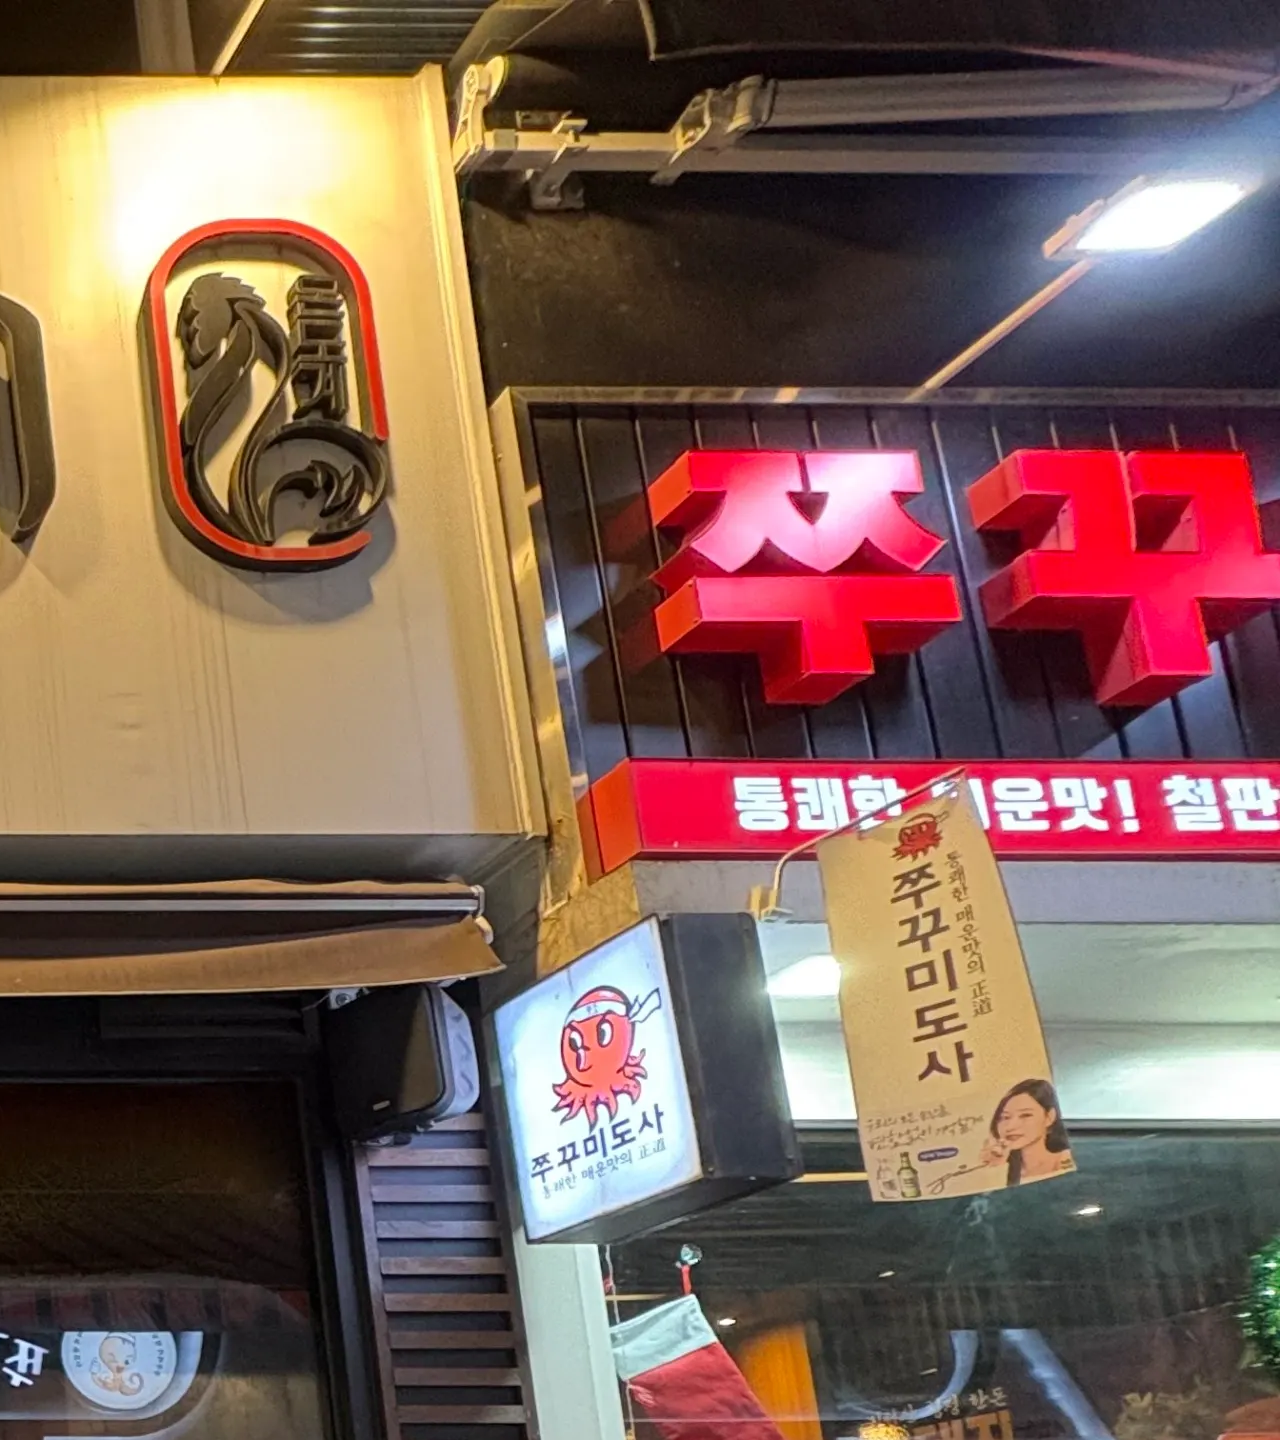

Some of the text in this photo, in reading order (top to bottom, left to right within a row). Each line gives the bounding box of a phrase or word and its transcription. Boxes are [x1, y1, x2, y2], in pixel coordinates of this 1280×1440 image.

[650, 449, 1280, 706] 쭈꾸
[733, 774, 1280, 833] 통쾌한 운맛! 철판
[890, 861, 975, 1083] 쭈꾸미도사
[531, 1104, 665, 1184] 쭈꾸미도사
